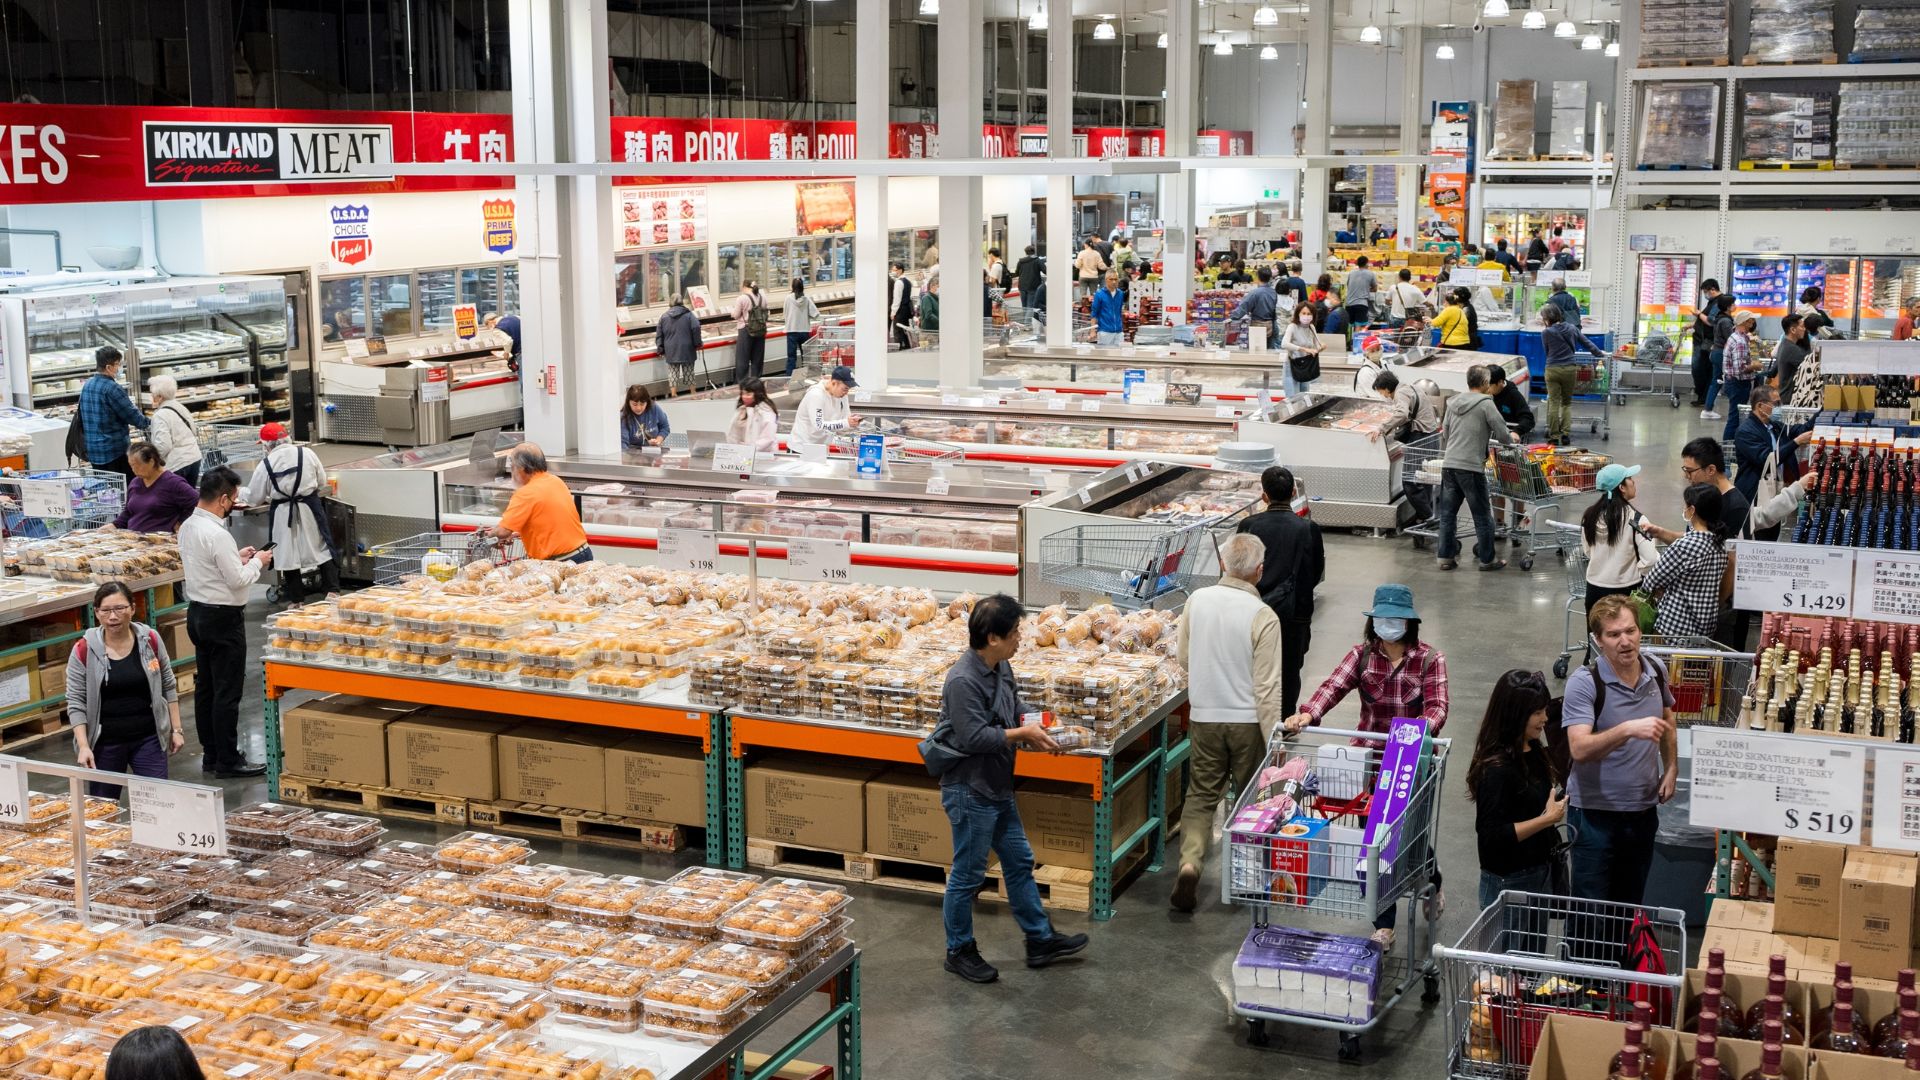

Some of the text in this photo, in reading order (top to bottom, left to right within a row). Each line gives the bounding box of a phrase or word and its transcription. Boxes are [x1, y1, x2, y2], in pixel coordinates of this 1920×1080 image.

[154, 131, 273, 159] KIRKLAND
[444, 129, 506, 162] 牛肉
[685, 131, 739, 162] PORK
[290, 132, 381, 175] MEAT
[154, 158, 273, 182] Signature
[333, 209, 368, 220] U.S.D.A.
[334, 224, 367, 235] CHOICE
[487, 221, 512, 229] PRIME
[489, 233, 512, 247] BEEF
[340, 243, 363, 261] Grade
[54, 507, 66, 515] 329
[689, 559, 713, 570] $ 198
[822, 568, 847, 579] $ 198
[1783, 593, 1845, 611] $ 1,429
[1715, 740, 1750, 750] 921081
[1696, 748, 1743, 759] KIRKLAND
[1715, 760, 1757, 770] BLENDED
[1759, 764, 1795, 775] SCOTCH
[1797, 768, 1834, 779] WHISKY
[1785, 808, 1853, 835] $ 519
[178, 832, 215, 848] $ 249
